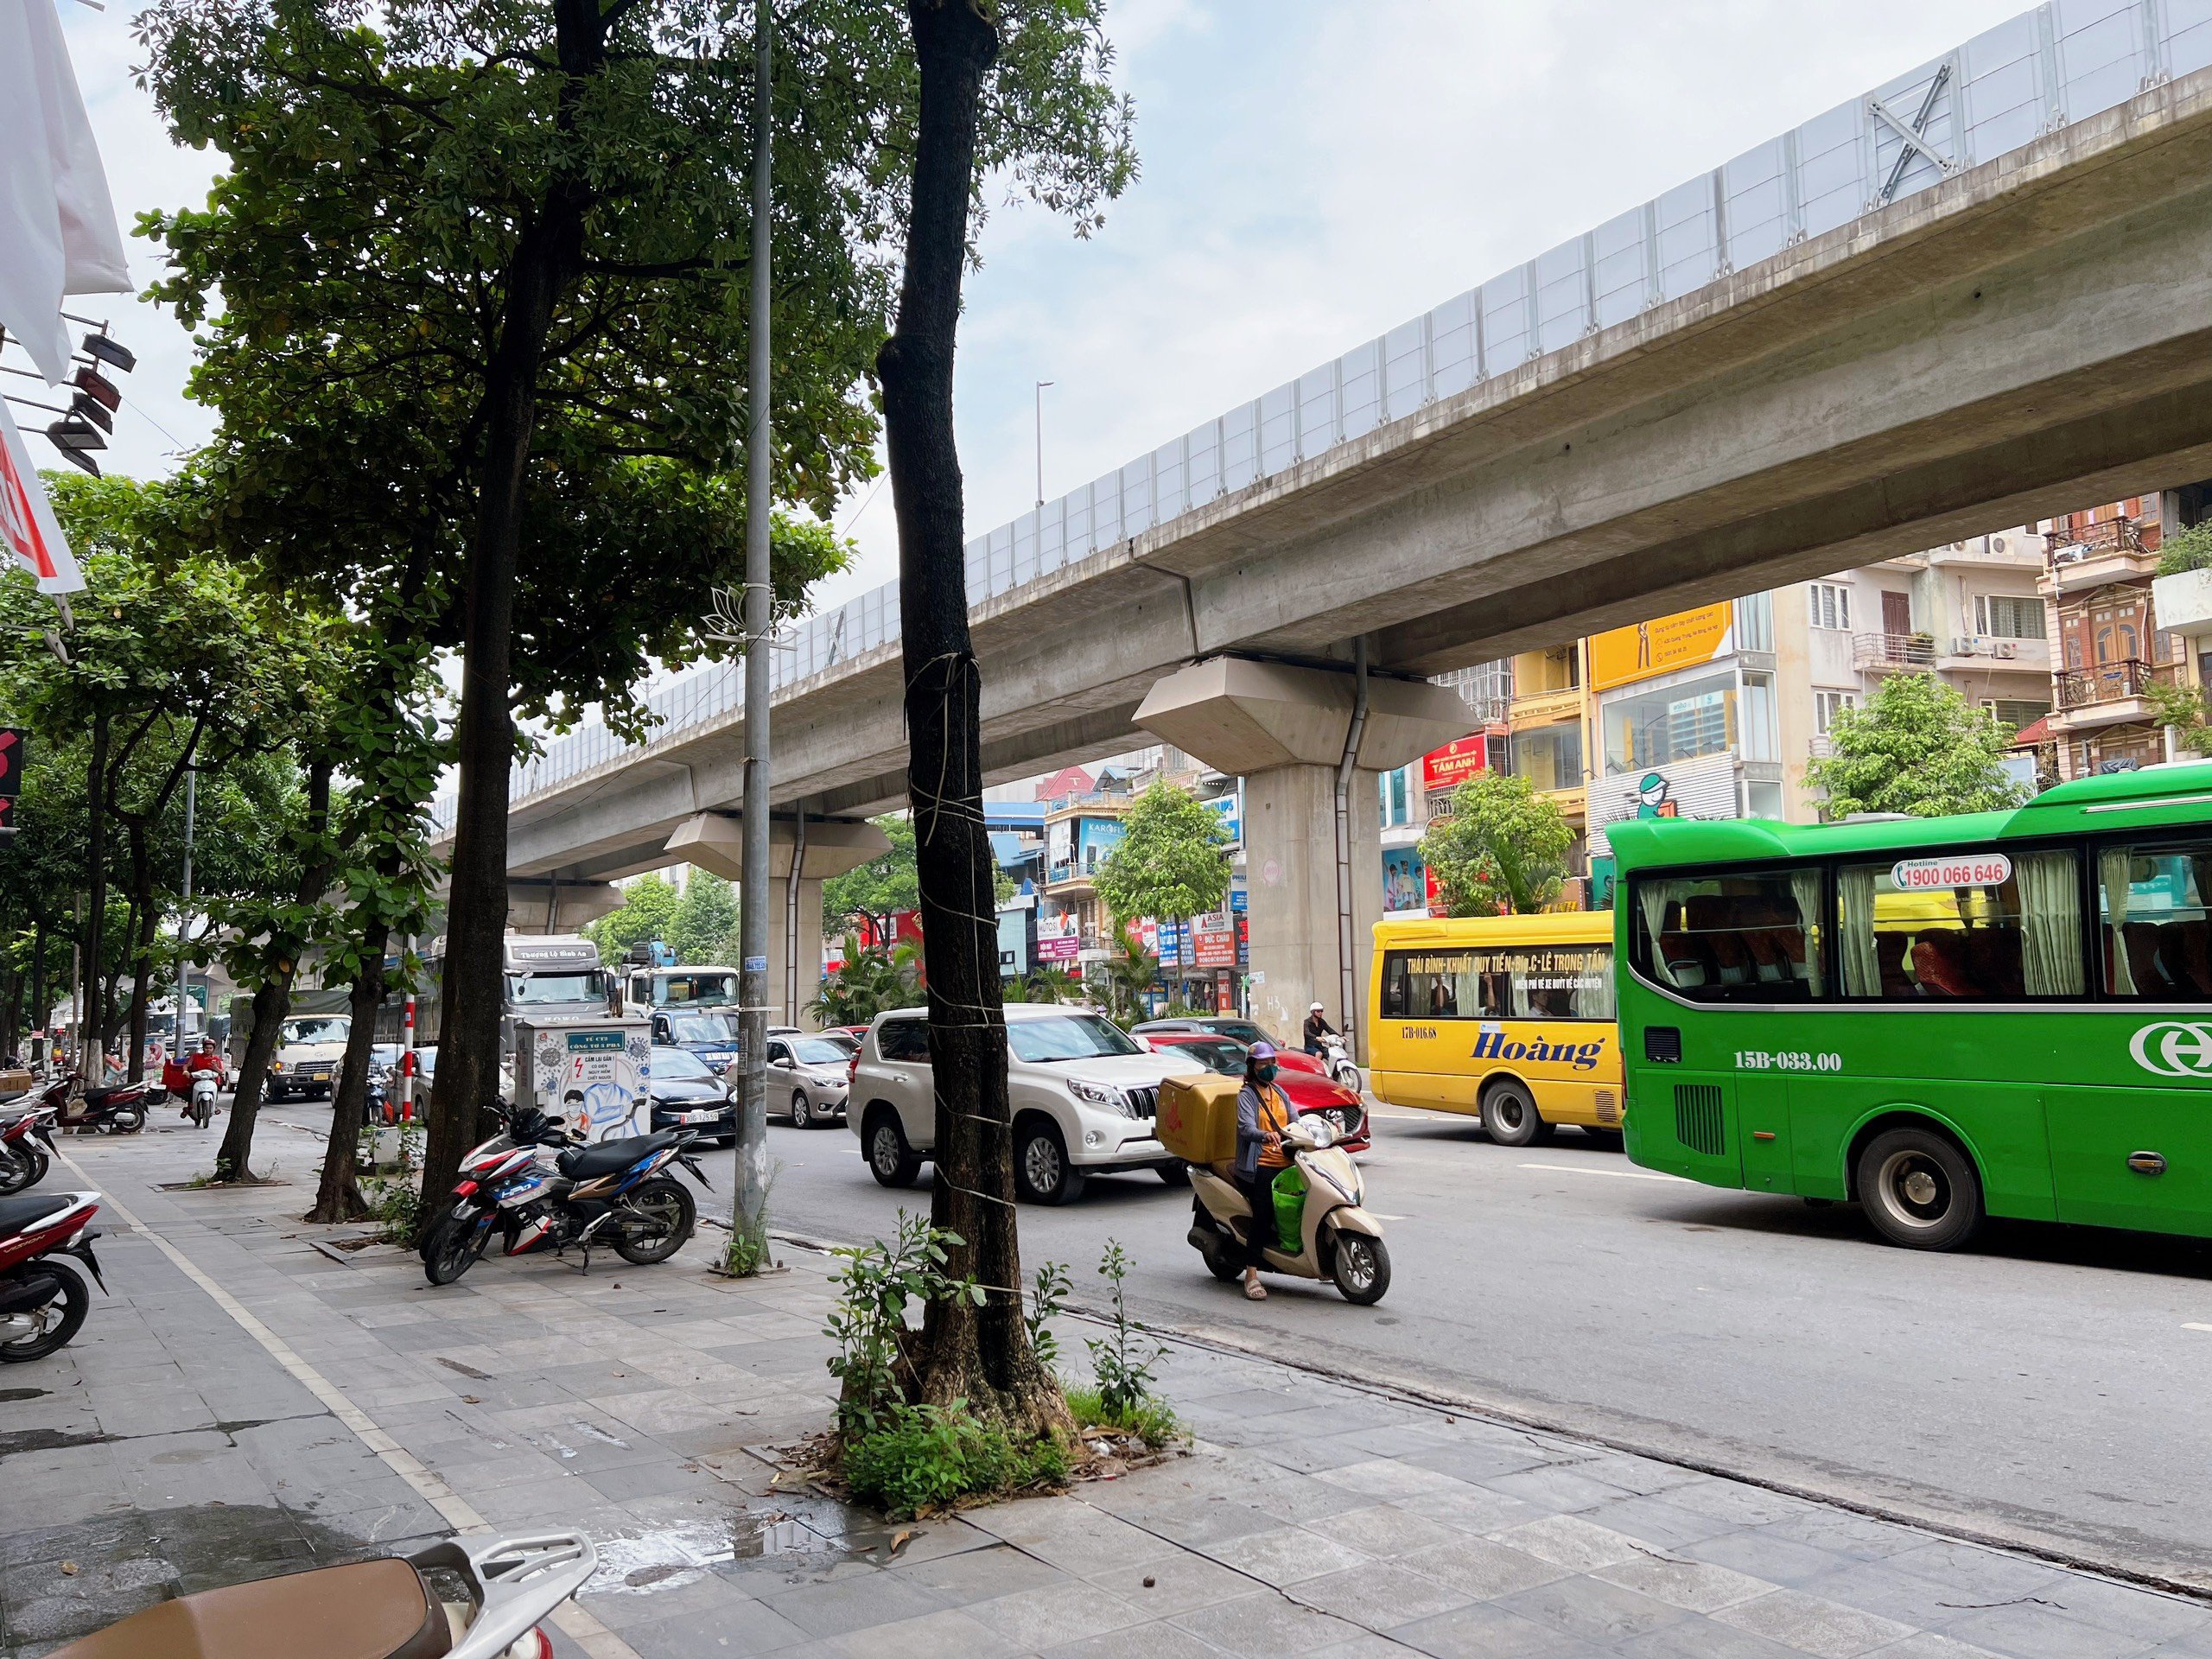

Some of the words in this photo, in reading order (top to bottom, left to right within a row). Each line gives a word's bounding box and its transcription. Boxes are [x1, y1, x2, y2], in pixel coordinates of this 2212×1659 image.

[1455, 757, 1475, 769] ANH
[1905, 868, 1939, 886] 1900
[1944, 866, 1971, 884] 066
[1974, 864, 2003, 882] 646
[1407, 955, 1423, 974] THÁI
[1474, 957, 1491, 973] DUY
[1554, 954, 1583, 975] TRỌNG
[1586, 948, 1605, 971] TẤN
[1545, 978, 1553, 989] XE
[1402, 1026, 1438, 1039] 17B-016.68
[1470, 1032, 1605, 1071] Hoàng
[1733, 1051, 1842, 1071] 15B-033.00
